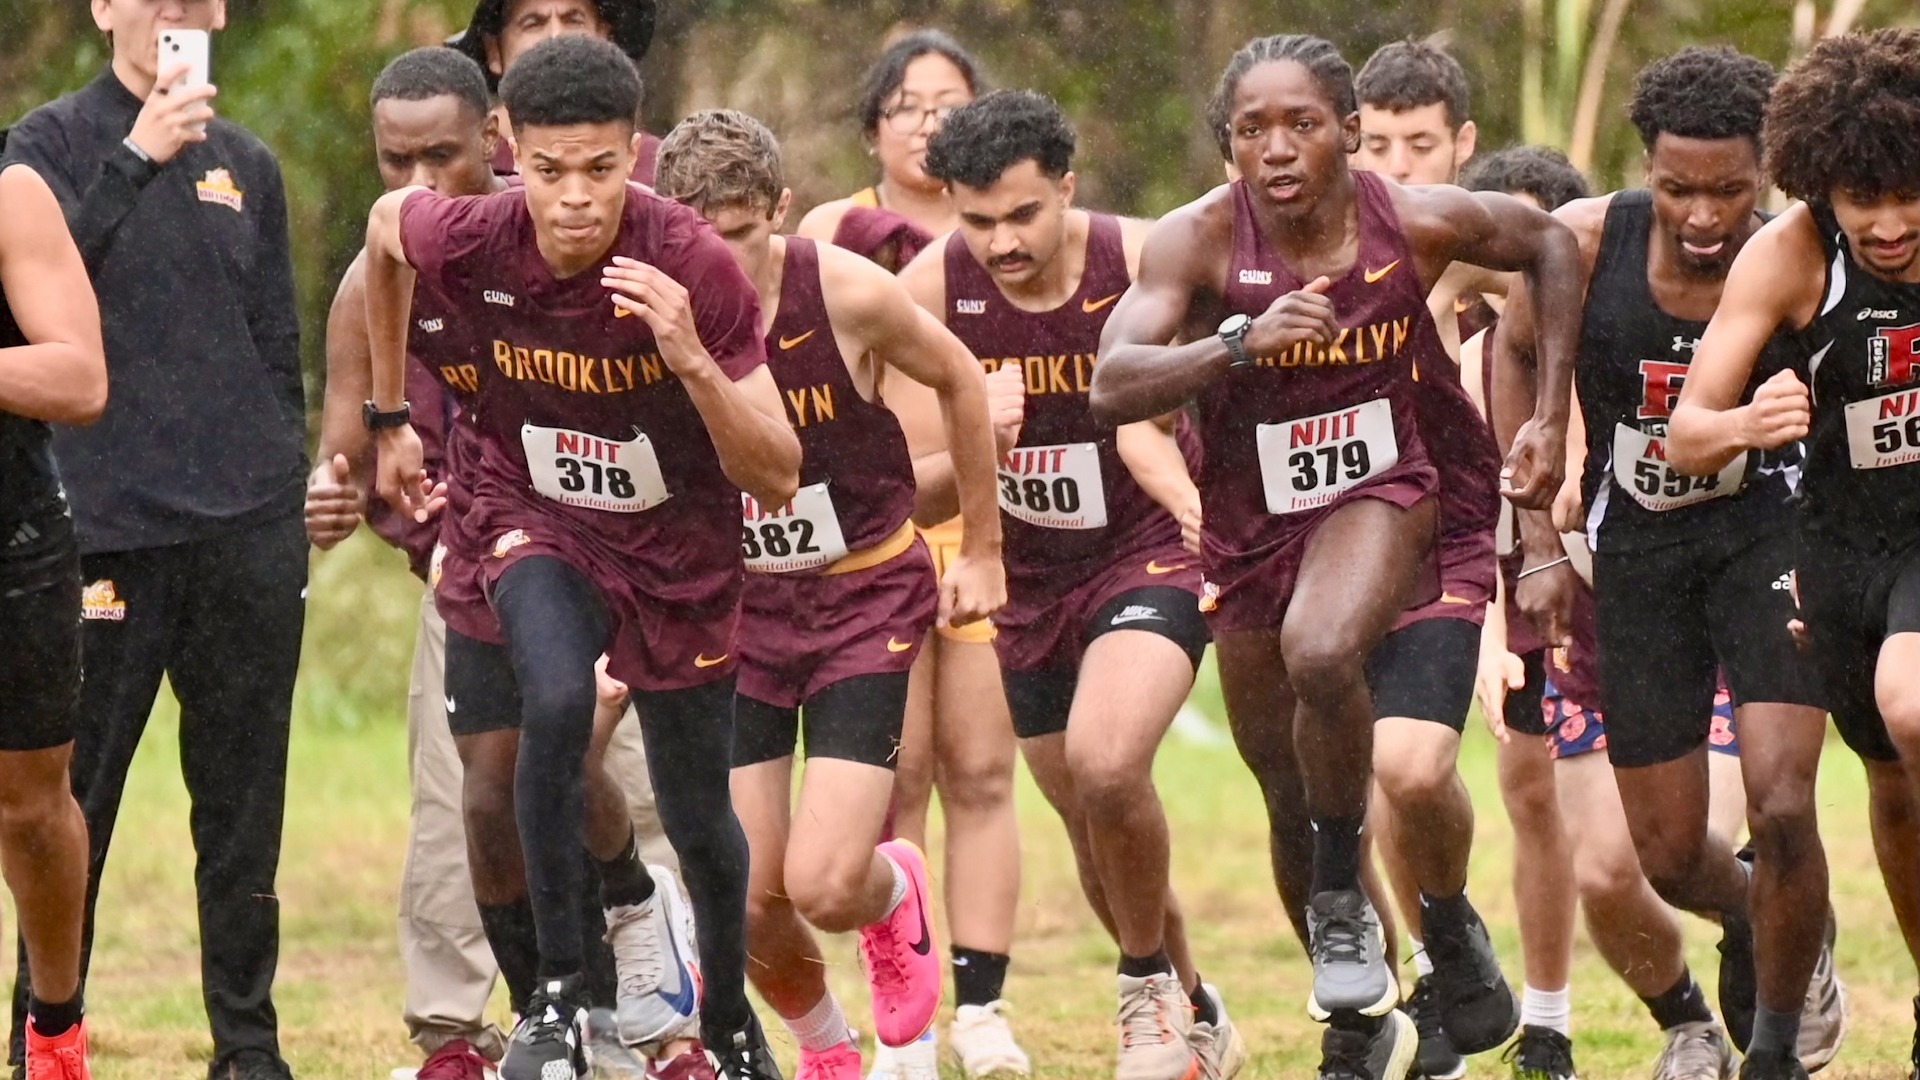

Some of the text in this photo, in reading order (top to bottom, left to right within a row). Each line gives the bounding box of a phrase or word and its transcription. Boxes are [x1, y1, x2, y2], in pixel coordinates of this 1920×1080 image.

[1239, 269, 1272, 285] CUNY
[483, 289, 515, 307] CUNY
[956, 299, 986, 314] CUNY
[1256, 315, 1410, 367] OOKLYN
[493, 339, 663, 394] BROOKLYN
[1872, 339, 1885, 383] NEWARK
[1290, 408, 1360, 450] NJIT
[556, 431, 622, 464] NJIT
[998, 448, 1063, 476] NJIT
[555, 457, 636, 499] 378
[1289, 439, 1370, 492] 379
[559, 493, 646, 511] Invitational
[998, 476, 1080, 514] 380
[1006, 501, 1084, 527] Invitational
[748, 554, 828, 571] nvitational
